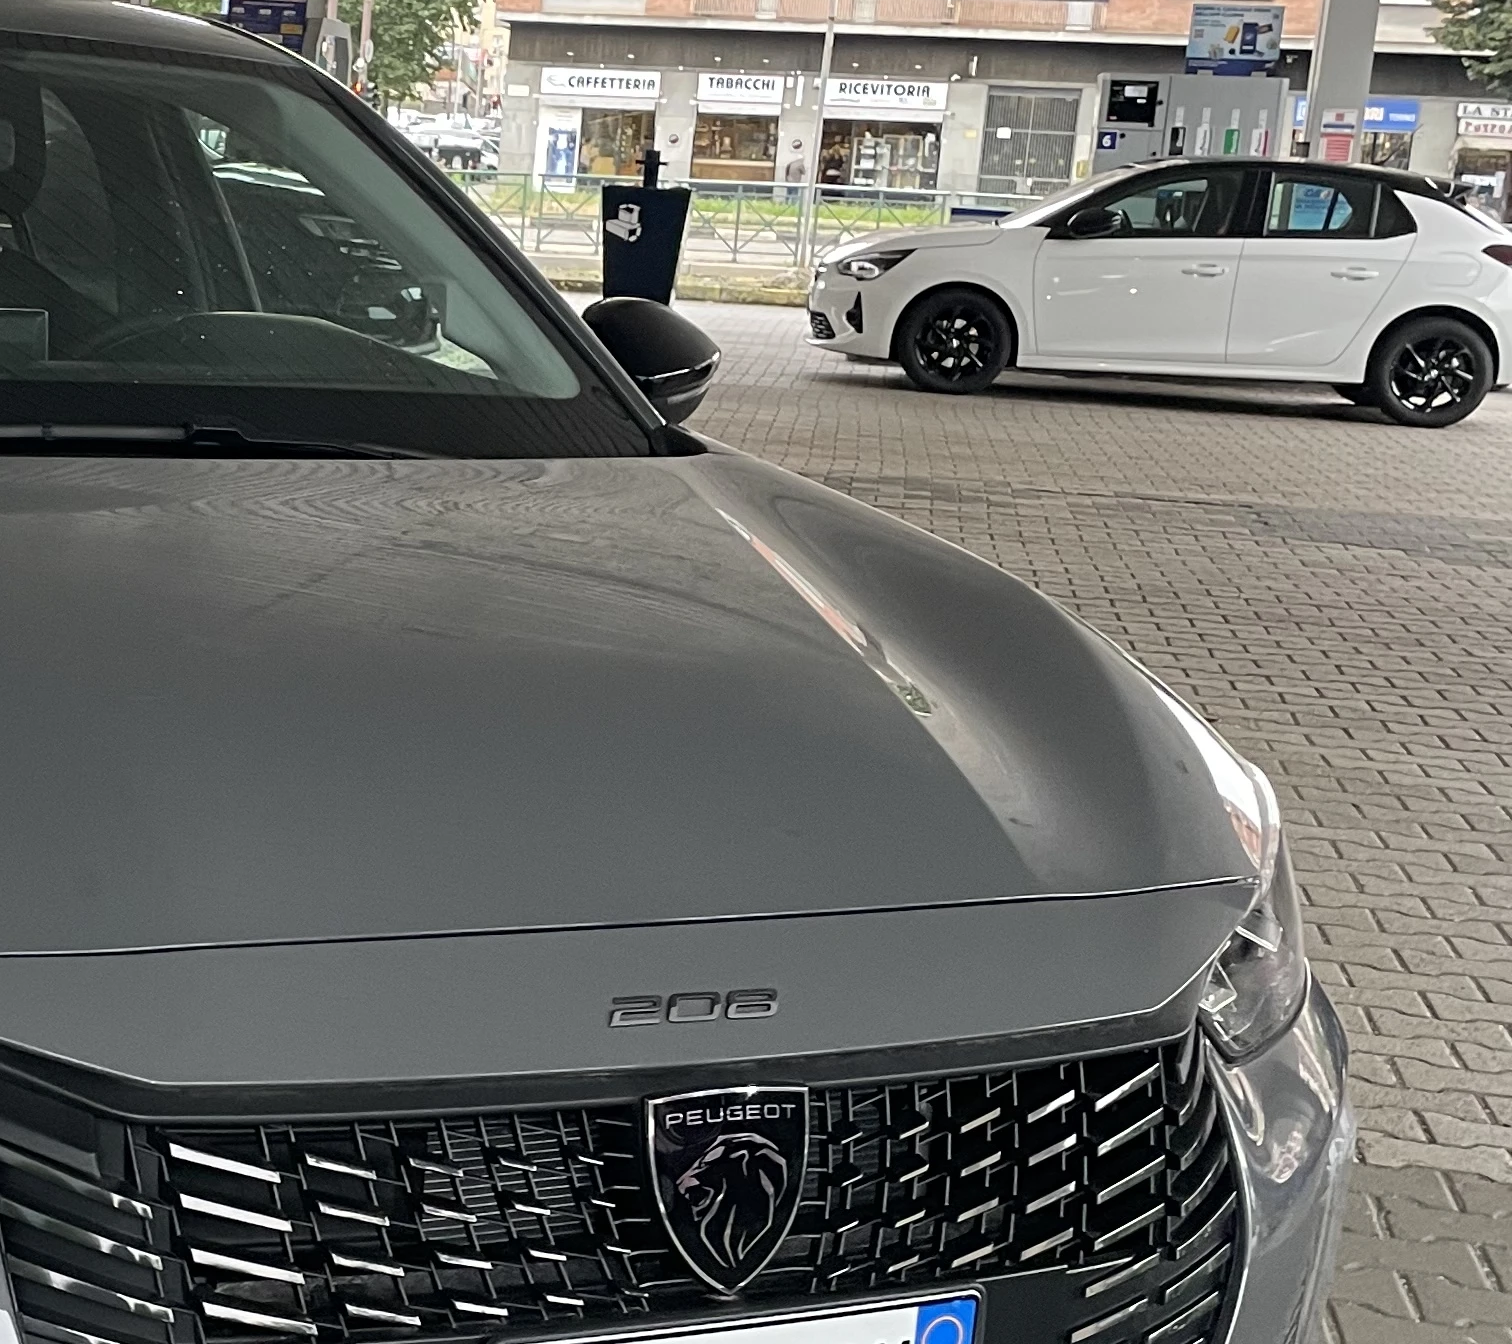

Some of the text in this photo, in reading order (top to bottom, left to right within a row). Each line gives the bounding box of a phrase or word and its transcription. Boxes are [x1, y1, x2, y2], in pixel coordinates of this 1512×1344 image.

[568, 75, 656, 91] CAFFETTERIA
[708, 76, 776, 91] TABACCHI
[838, 82, 931, 98] RICEVITORIA
[1463, 105, 1512, 117] LA ST
[1102, 135, 1112, 147] 6
[608, 987, 780, 1027] 208
[665, 1103, 797, 1130] PEUGEOT
